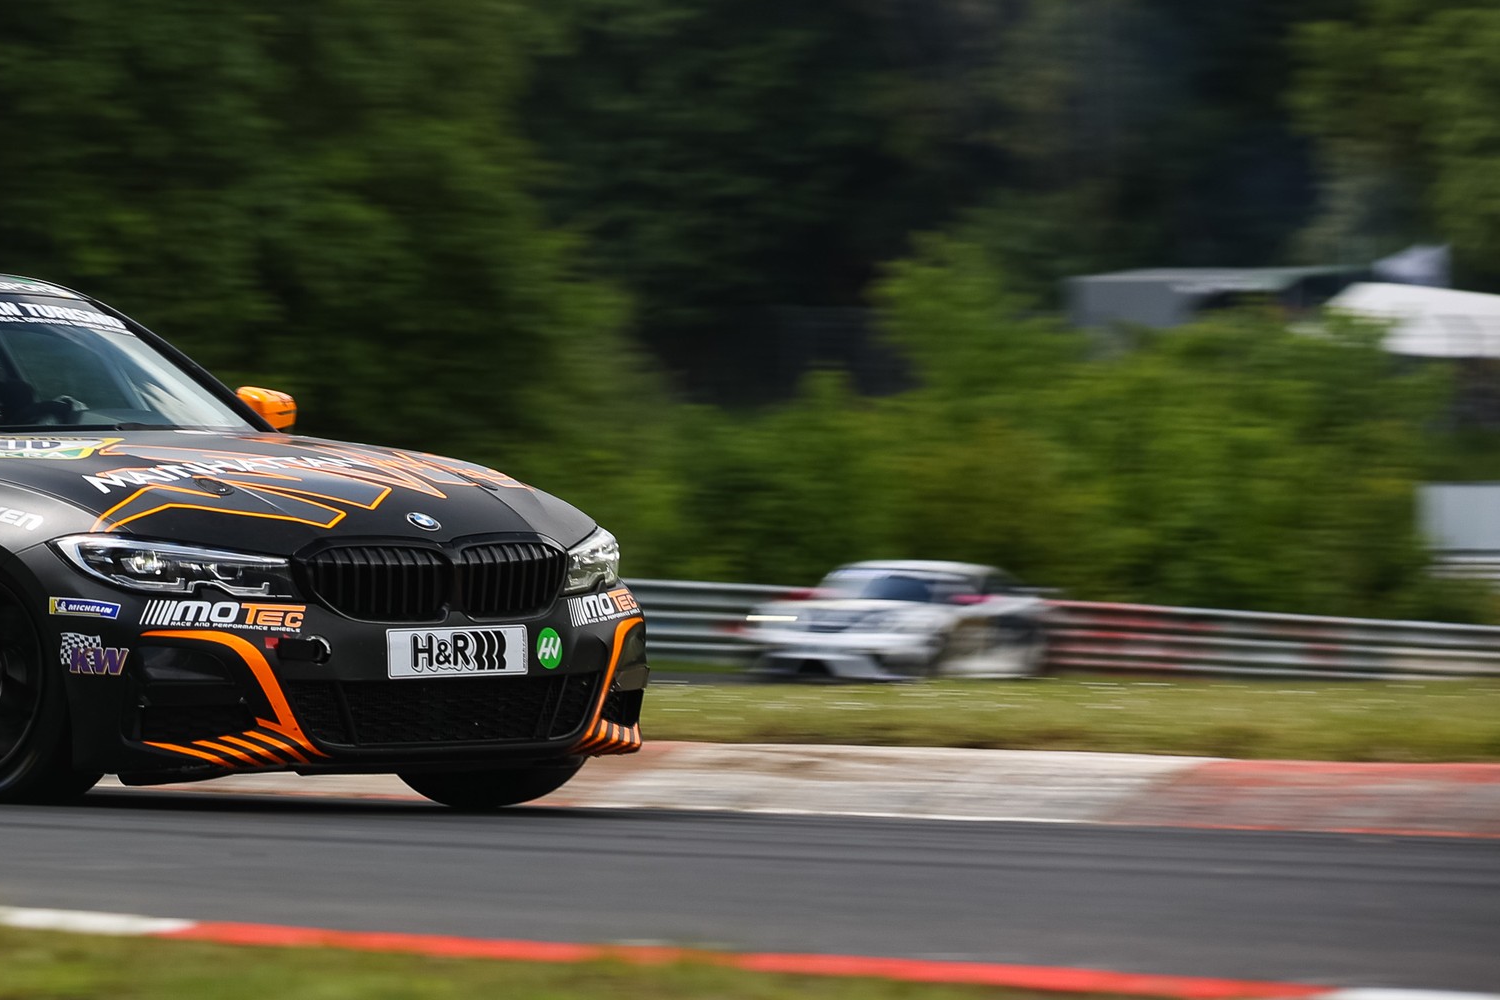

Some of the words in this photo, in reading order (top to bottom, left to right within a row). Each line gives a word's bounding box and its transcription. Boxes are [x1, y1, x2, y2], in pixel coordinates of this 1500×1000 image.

[18, 302, 128, 330] TURISMO
[67, 603, 113, 614] MICHELIN
[212, 622, 268, 631] PERFORMANCE
[69, 647, 130, 676] KW
[411, 632, 475, 672] H&R
